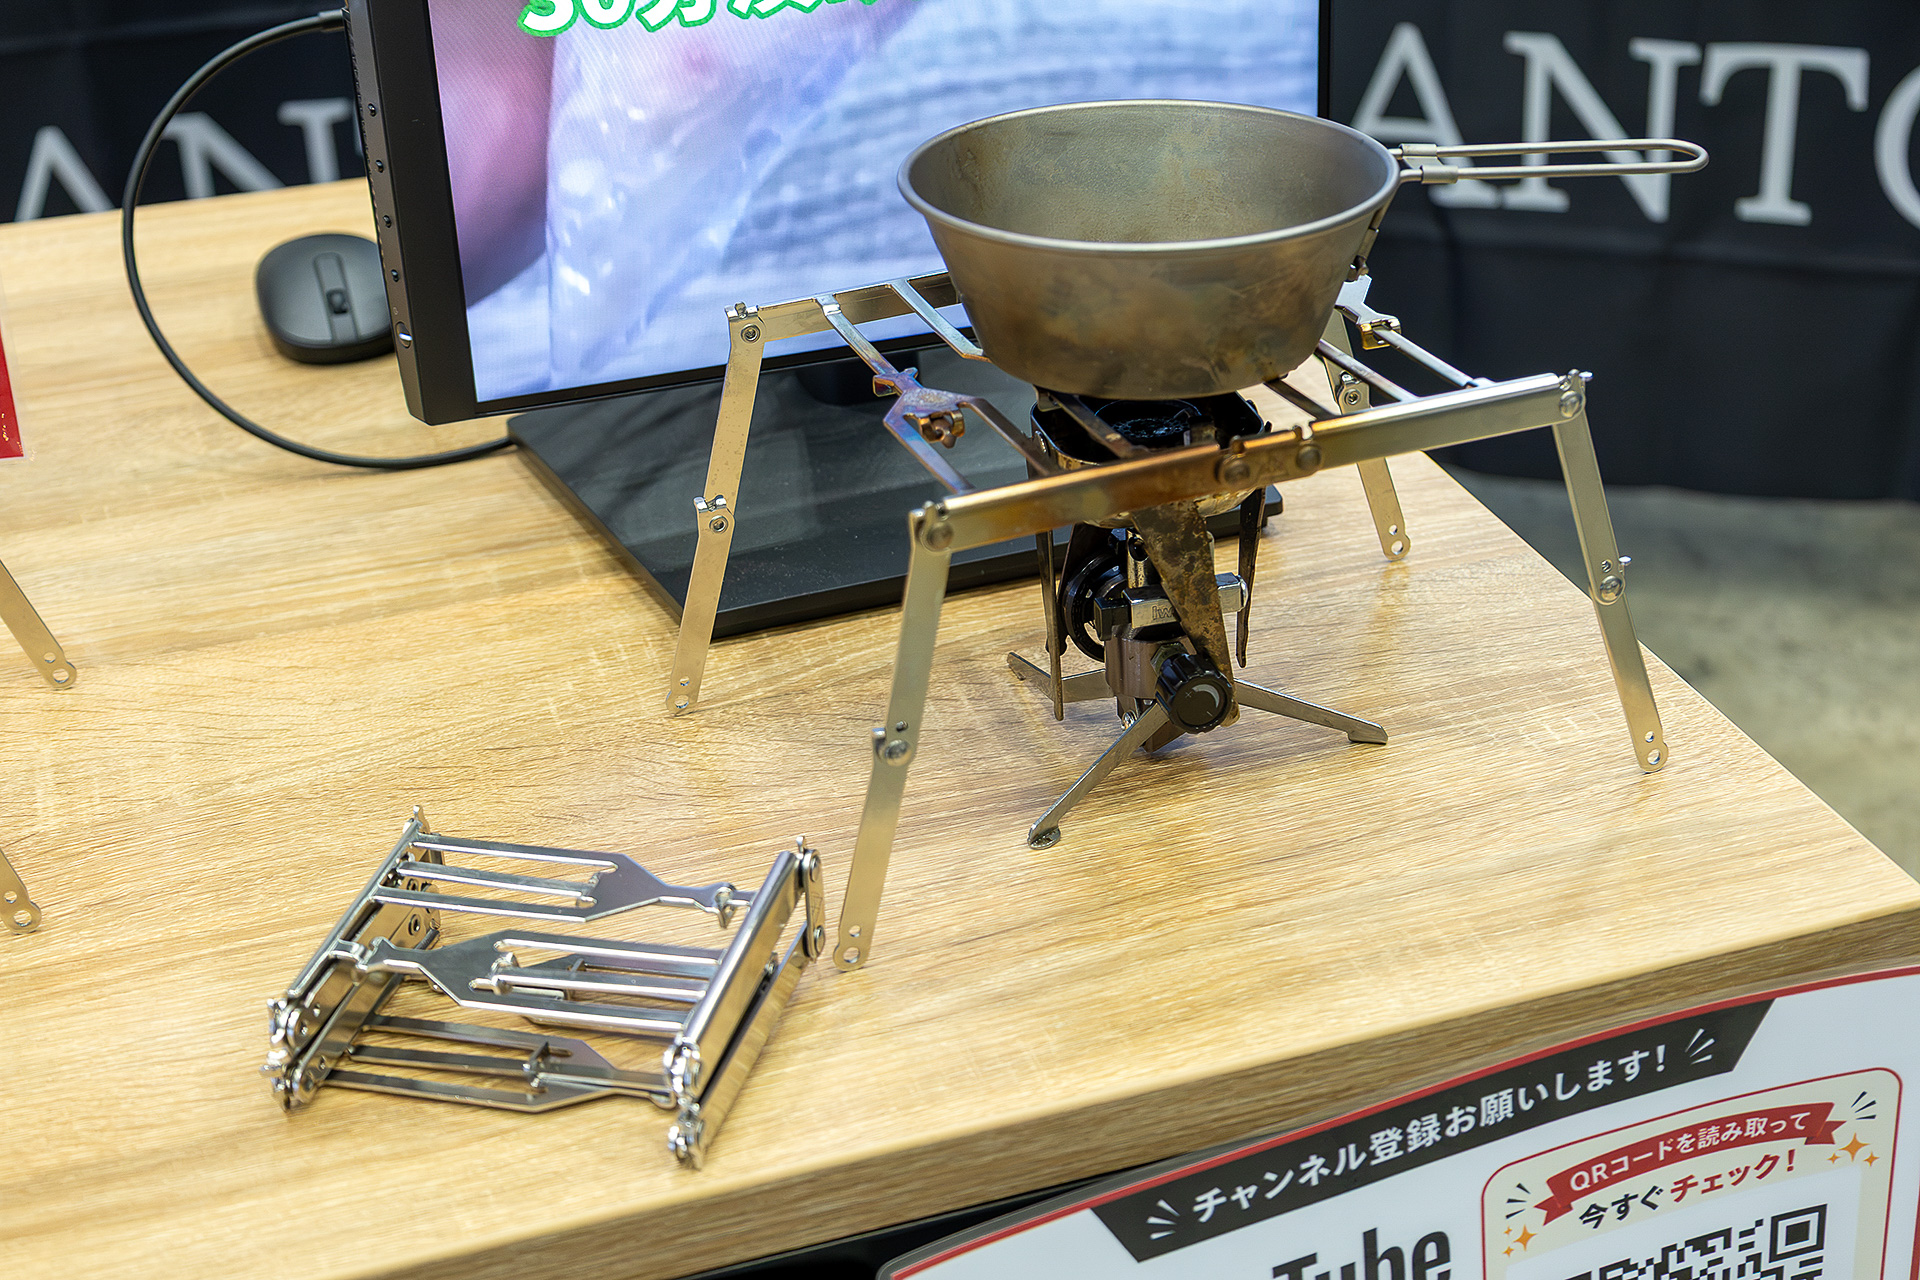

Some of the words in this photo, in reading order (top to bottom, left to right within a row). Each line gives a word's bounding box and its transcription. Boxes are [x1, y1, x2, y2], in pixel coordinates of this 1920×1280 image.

[1350, 20, 1920, 231] ANT
[1192, 1044, 1666, 1223] チャンネル登録お願いします！
[1569, 1111, 1812, 1192] QRコードを読み取って
[1578, 1148, 1797, 1230] 今すぐチェック！
